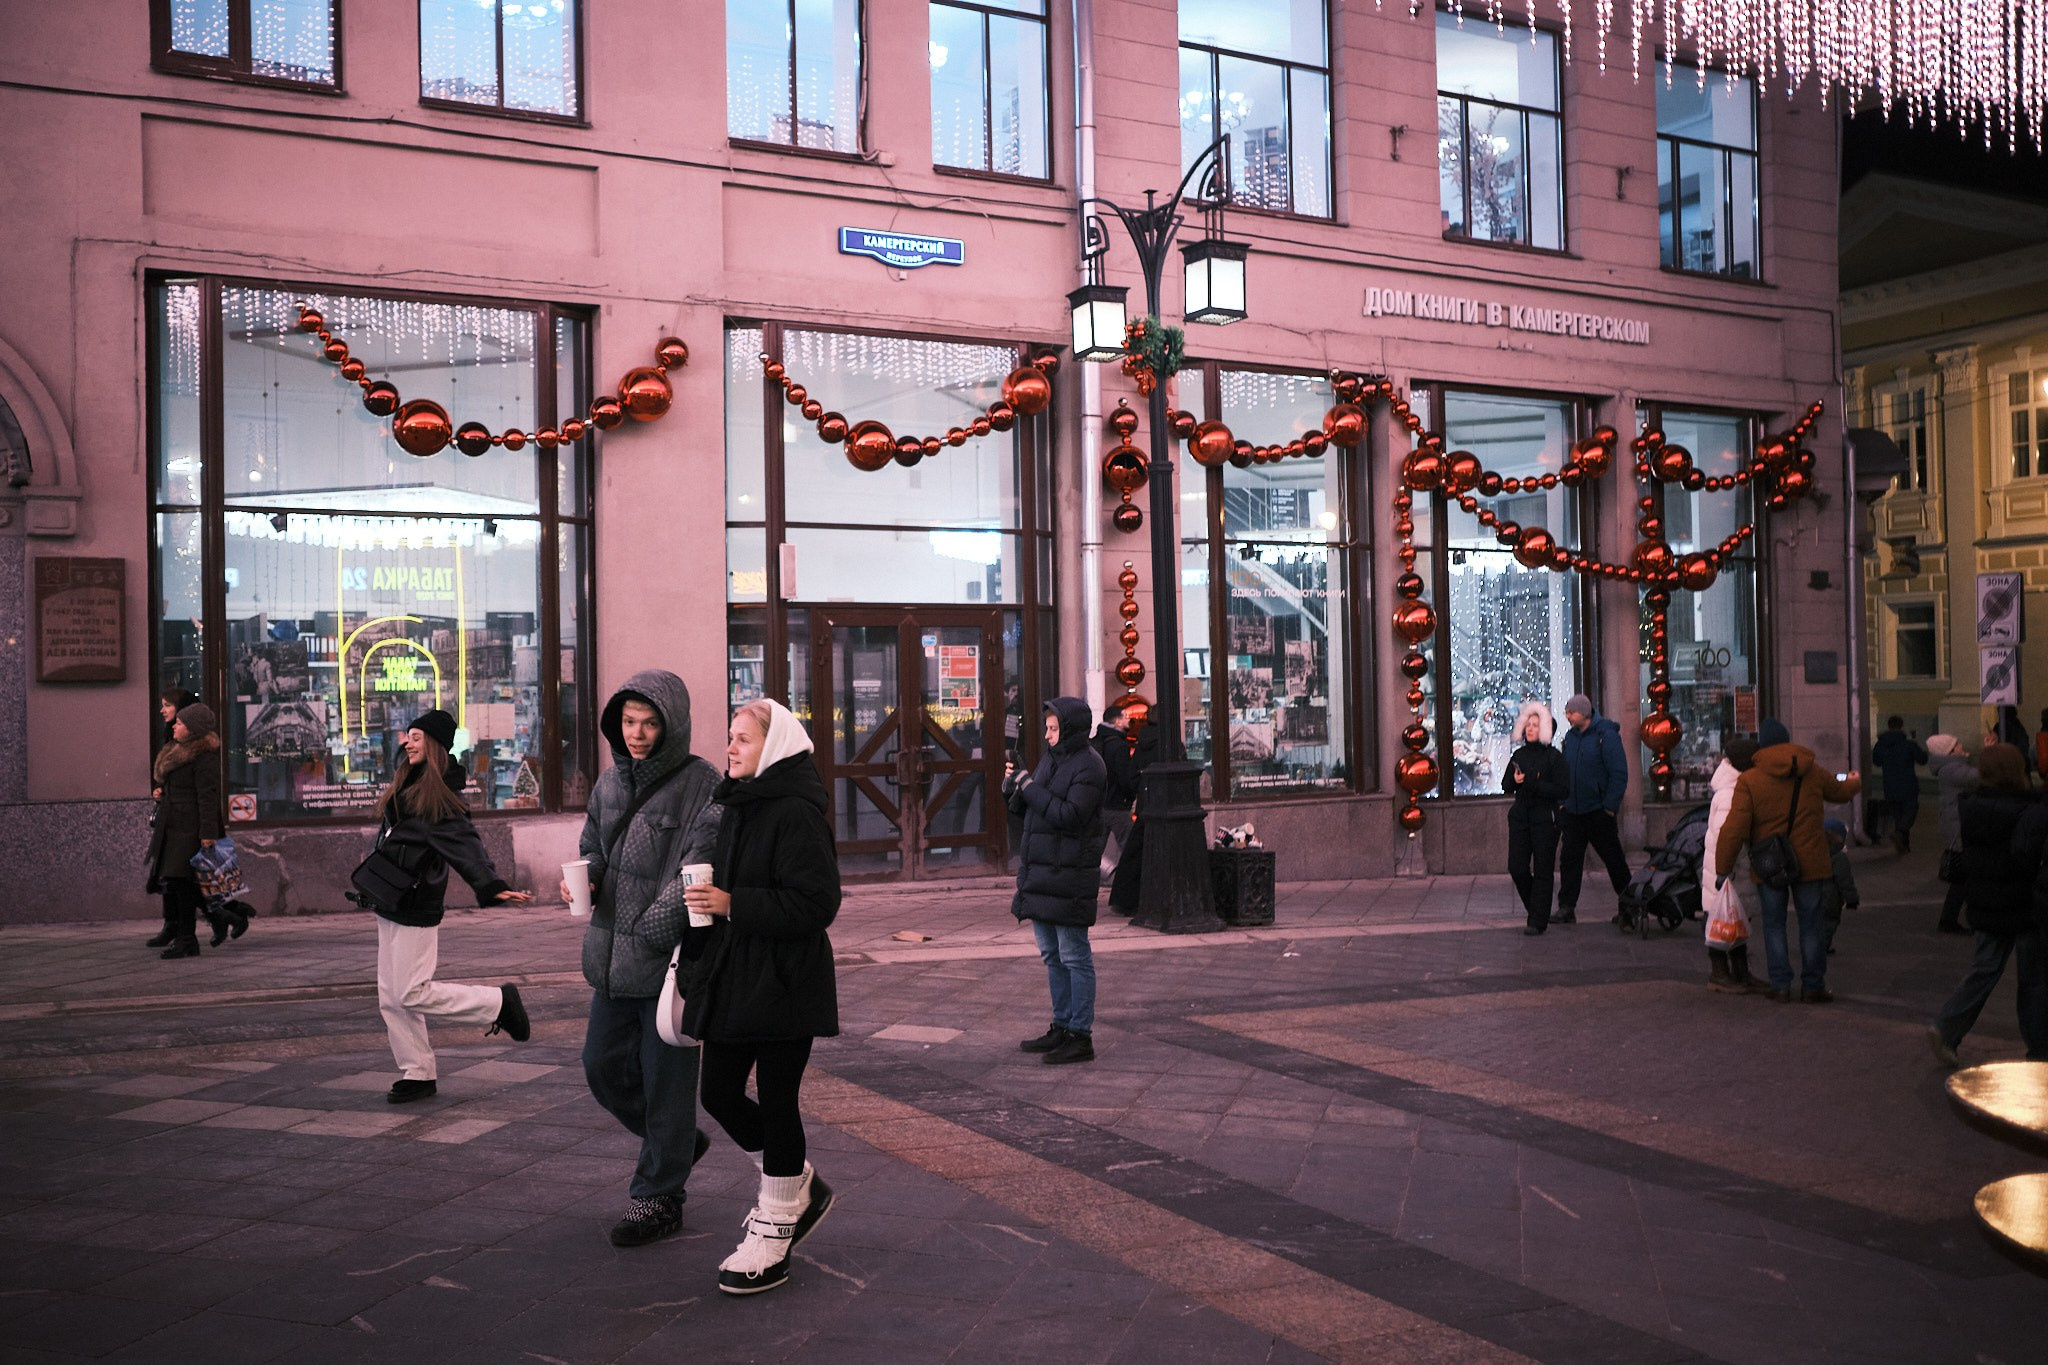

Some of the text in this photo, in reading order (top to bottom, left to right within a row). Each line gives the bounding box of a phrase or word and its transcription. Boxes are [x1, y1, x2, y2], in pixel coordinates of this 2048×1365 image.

[863, 235, 945, 254] КАМЕРГЕРСКИЙ
[886, 252, 923, 263] ПЕРЕУЛОК
[1363, 287, 1650, 344] ДОМ КНИГИ В КАМЕРГЕРСКОМ
[1986, 577, 2010, 587] ЗОНА
[1231, 588, 1262, 599] ЗДЕСЬ
[1316, 588, 1346, 599] КНИГИ
[47, 648, 117, 657] ЛЕВ КАССИЛЬ
[302, 784, 342, 792] Мгновения
